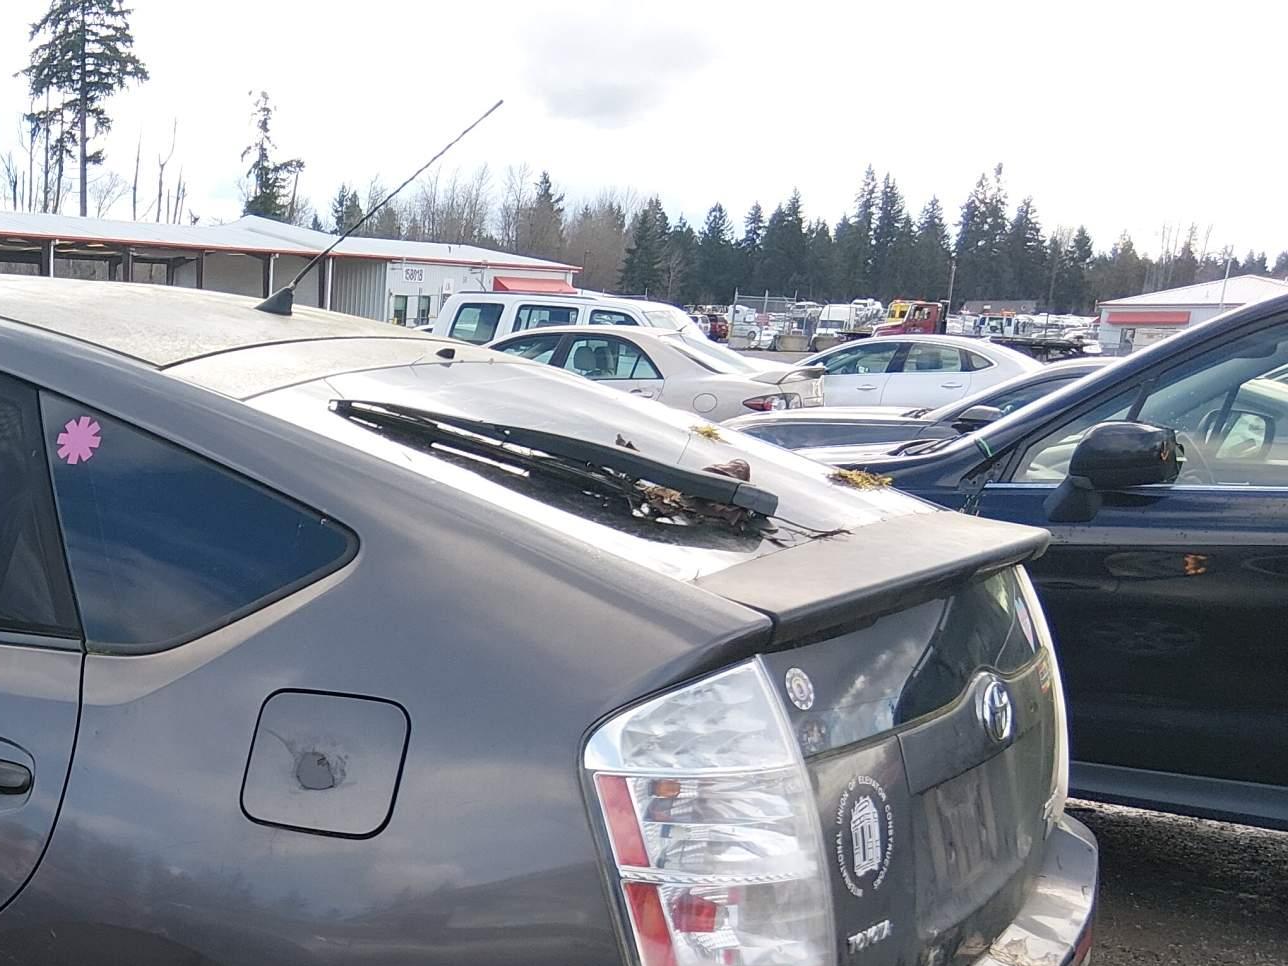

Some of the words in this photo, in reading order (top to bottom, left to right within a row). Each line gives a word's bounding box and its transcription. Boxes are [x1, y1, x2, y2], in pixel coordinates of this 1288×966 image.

[836, 790, 849, 824] UNION
[847, 779, 857, 792] OF
[857, 775, 887, 802] ELEVATOR
[847, 919, 892, 954] TOYOTA
